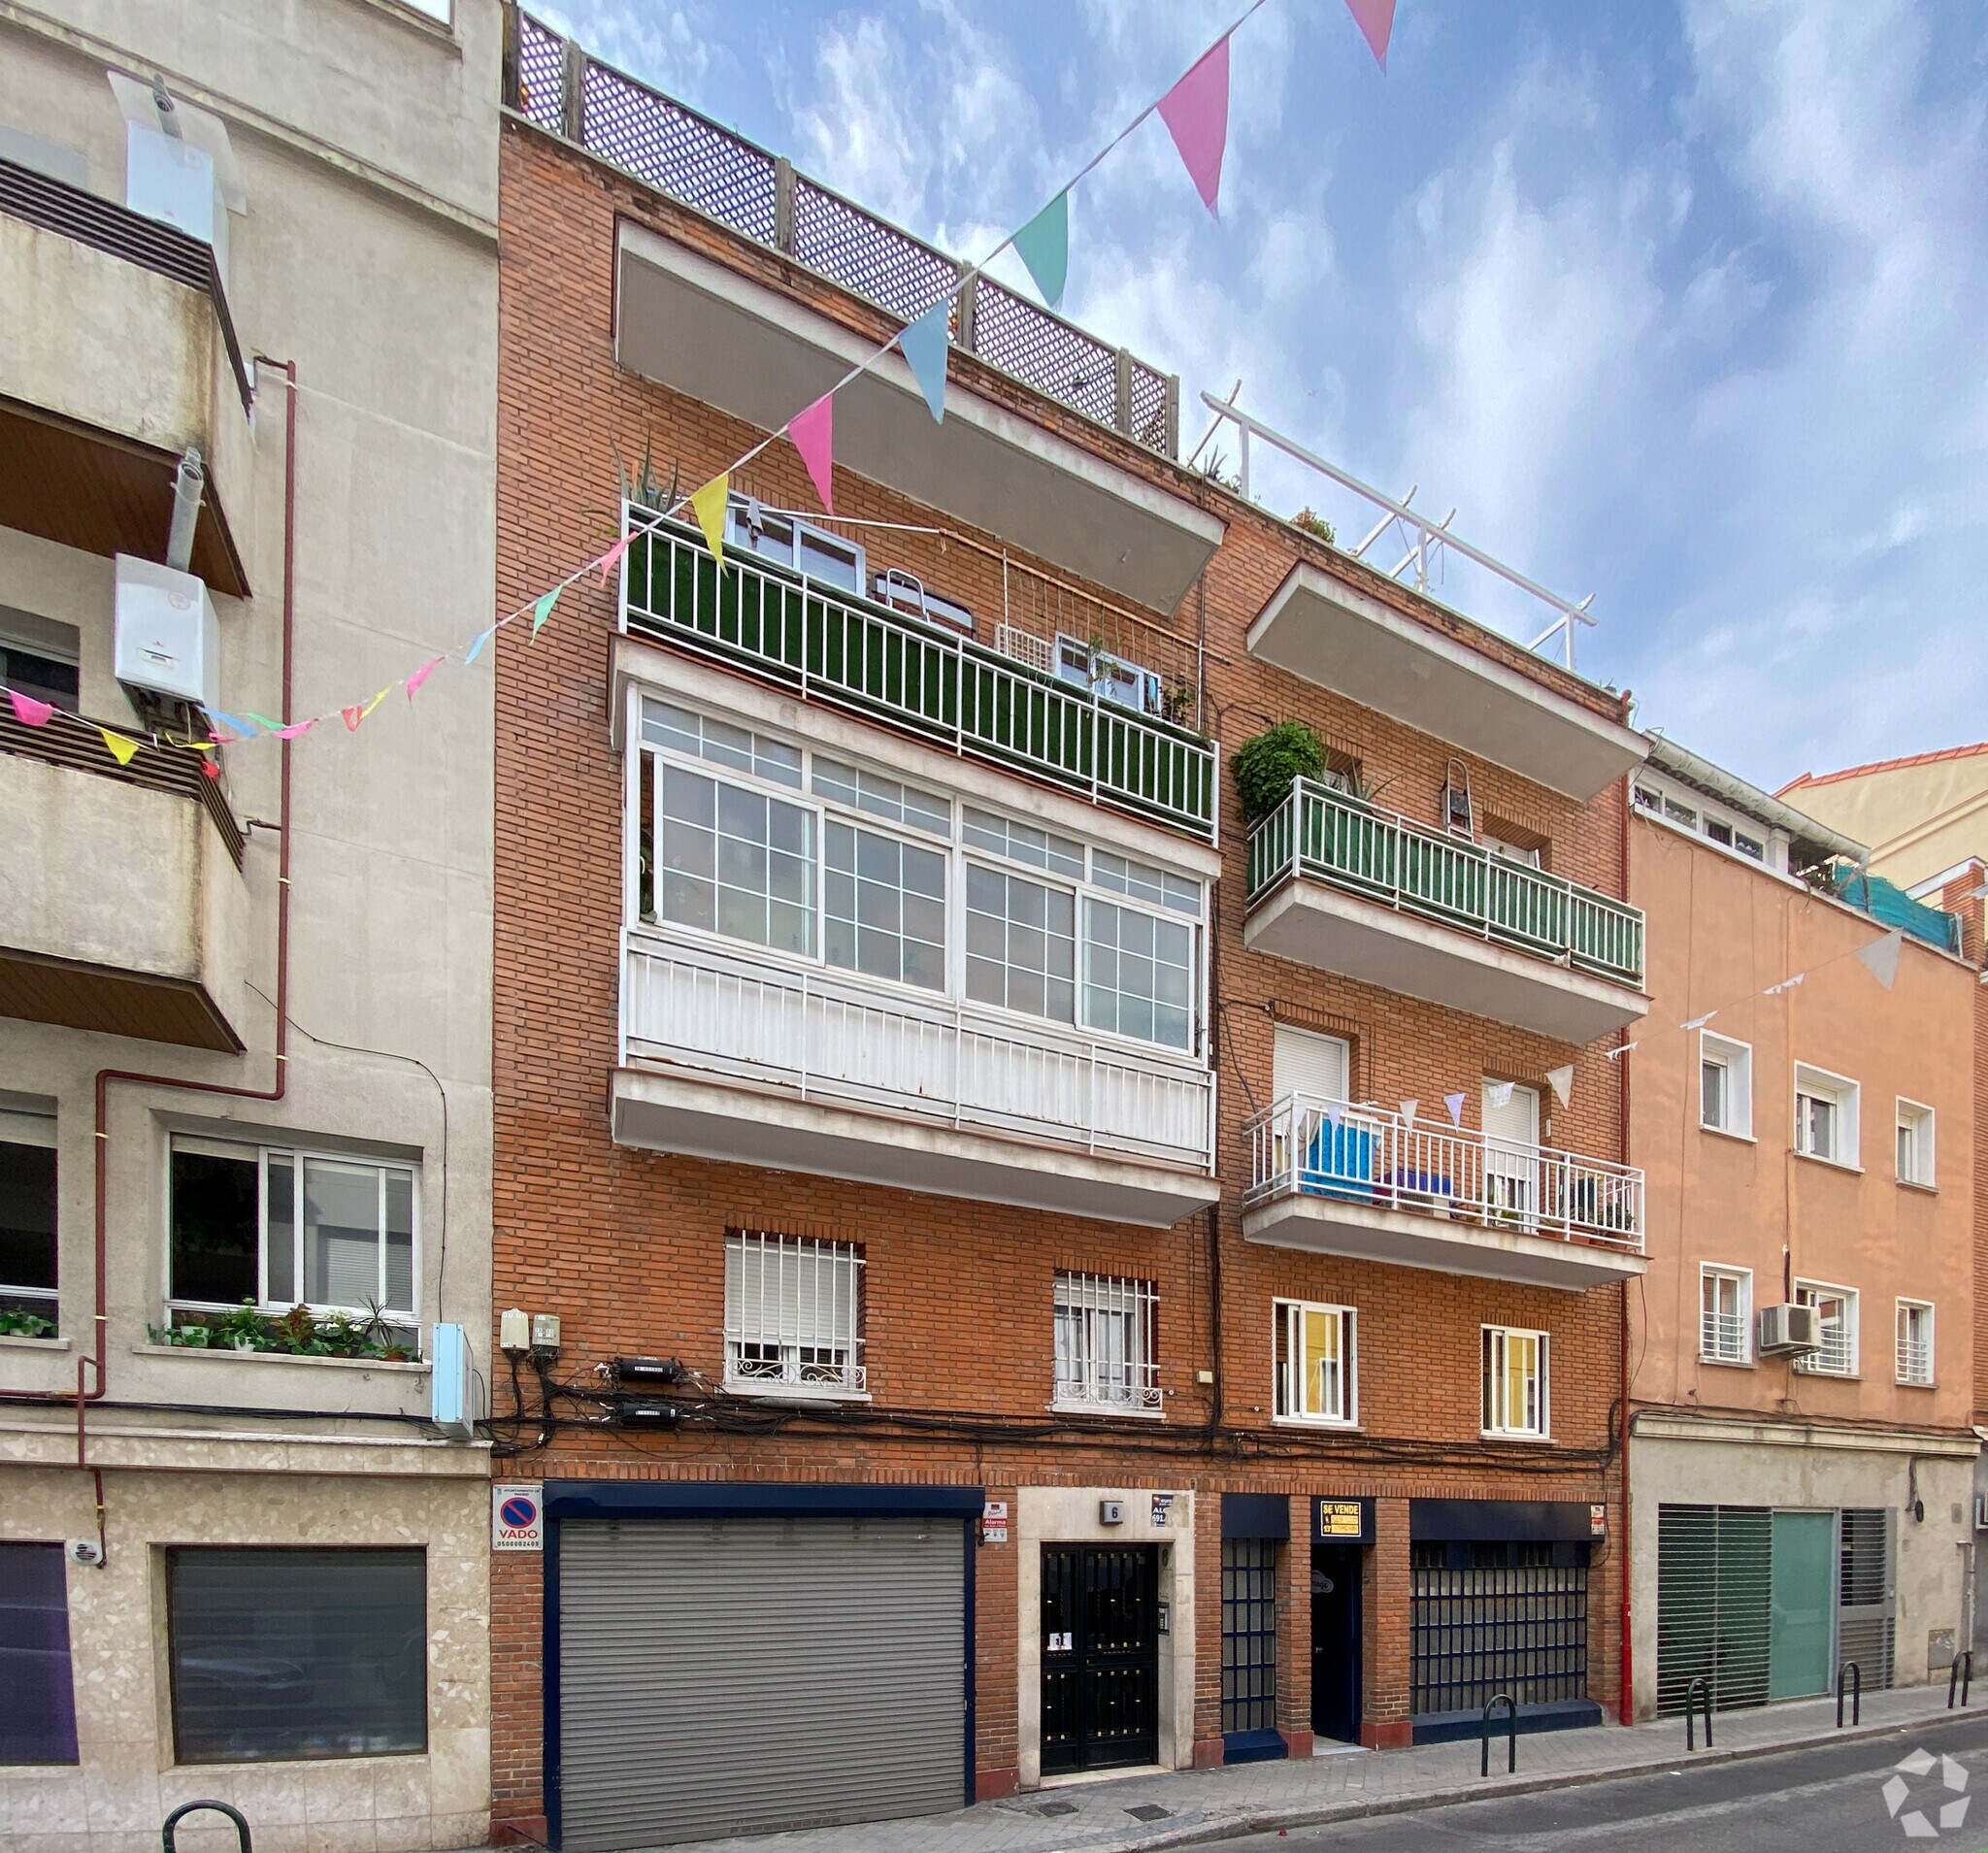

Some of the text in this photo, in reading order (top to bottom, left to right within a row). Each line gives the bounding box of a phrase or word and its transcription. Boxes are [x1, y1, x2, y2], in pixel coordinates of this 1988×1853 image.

[1111, 1506, 1118, 1518] 6
[1323, 1505, 1359, 1514] SE VENDE
[499, 1530, 539, 1539] VADO
